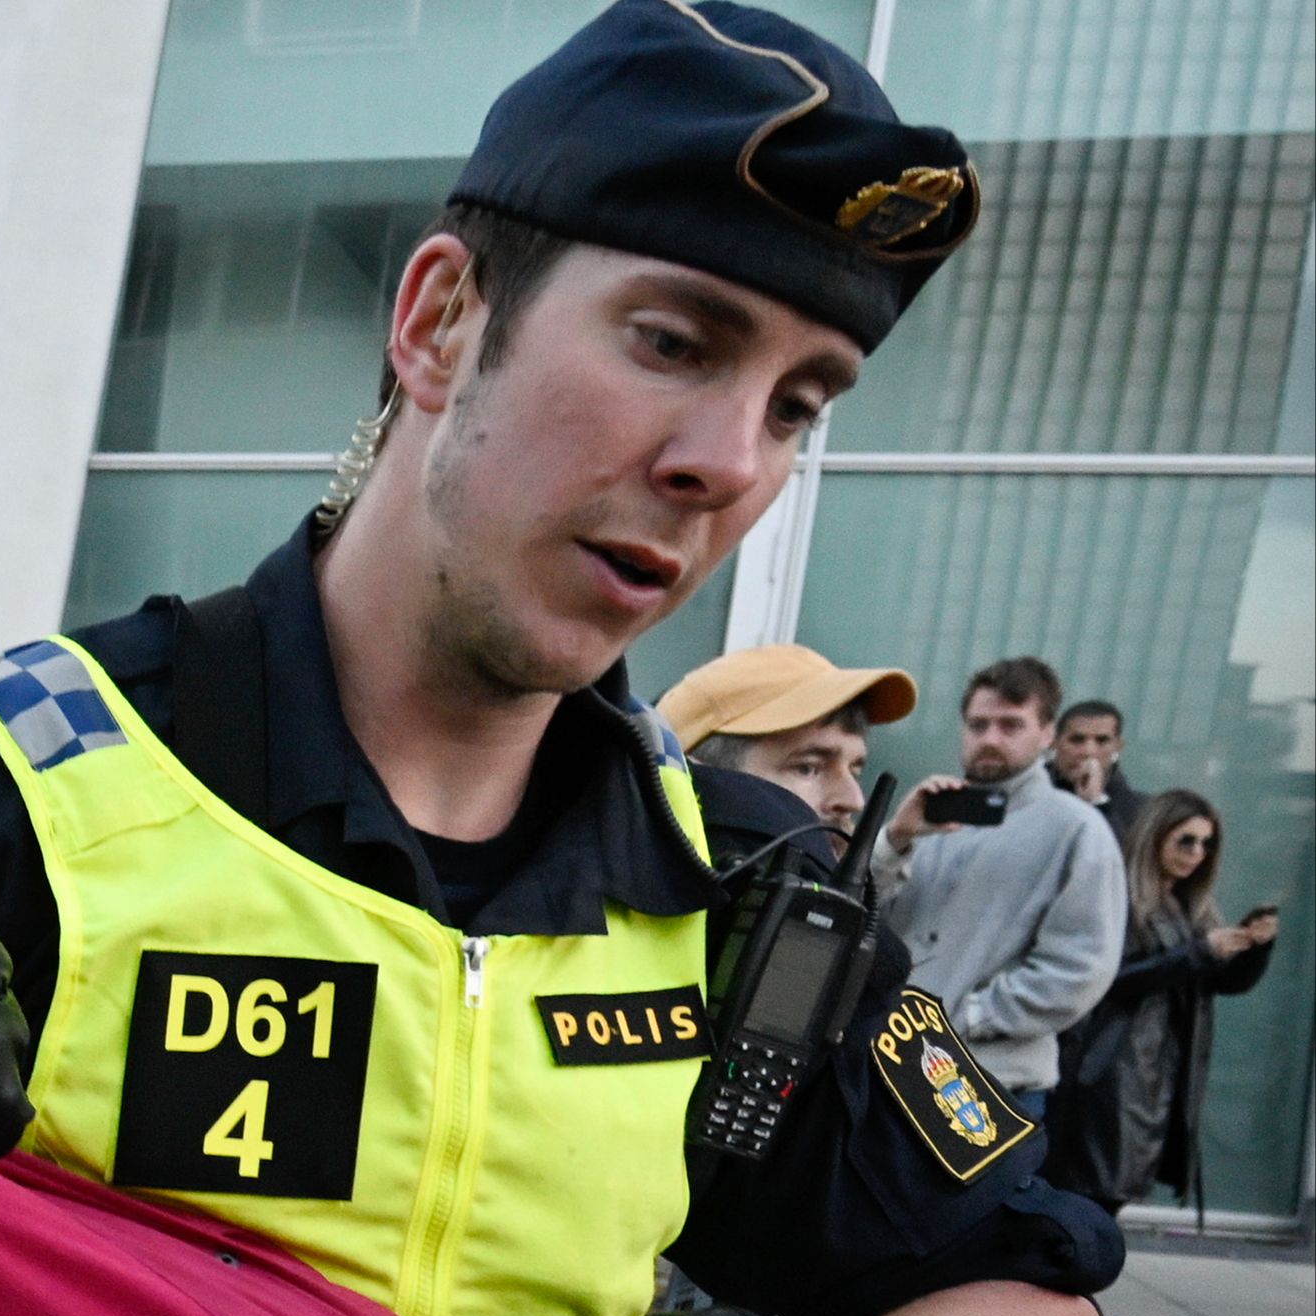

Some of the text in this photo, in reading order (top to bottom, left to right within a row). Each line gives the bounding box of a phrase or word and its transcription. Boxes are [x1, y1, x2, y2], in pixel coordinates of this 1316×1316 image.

[165, 974, 335, 1058] D61
[552, 1005, 697, 1046] POLIS
[877, 1000, 943, 1065] POLIS
[203, 1079, 274, 1178] 4
